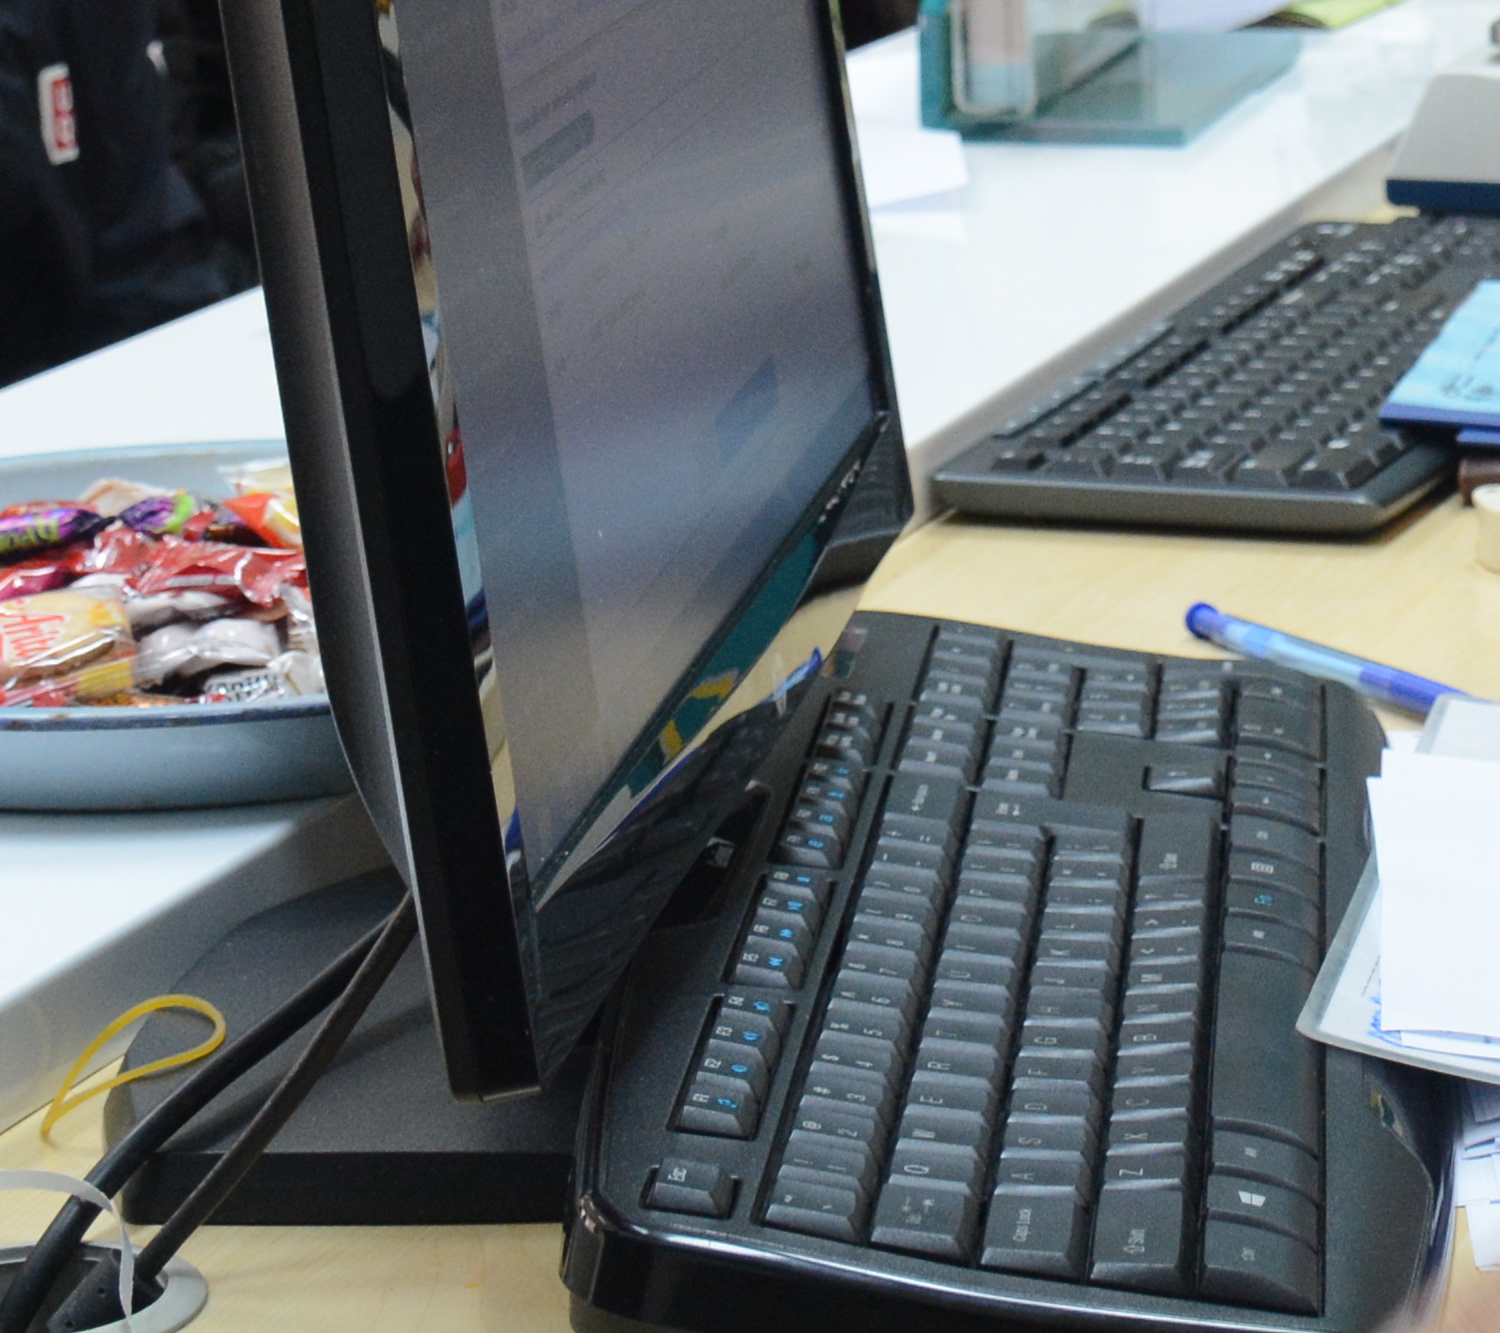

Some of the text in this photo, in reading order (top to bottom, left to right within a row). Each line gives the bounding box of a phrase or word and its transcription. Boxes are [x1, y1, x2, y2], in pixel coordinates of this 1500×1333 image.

[1018, 1135, 1042, 1146] S
[1010, 1171, 1034, 1181] A
[1118, 1167, 1144, 1177] Z
